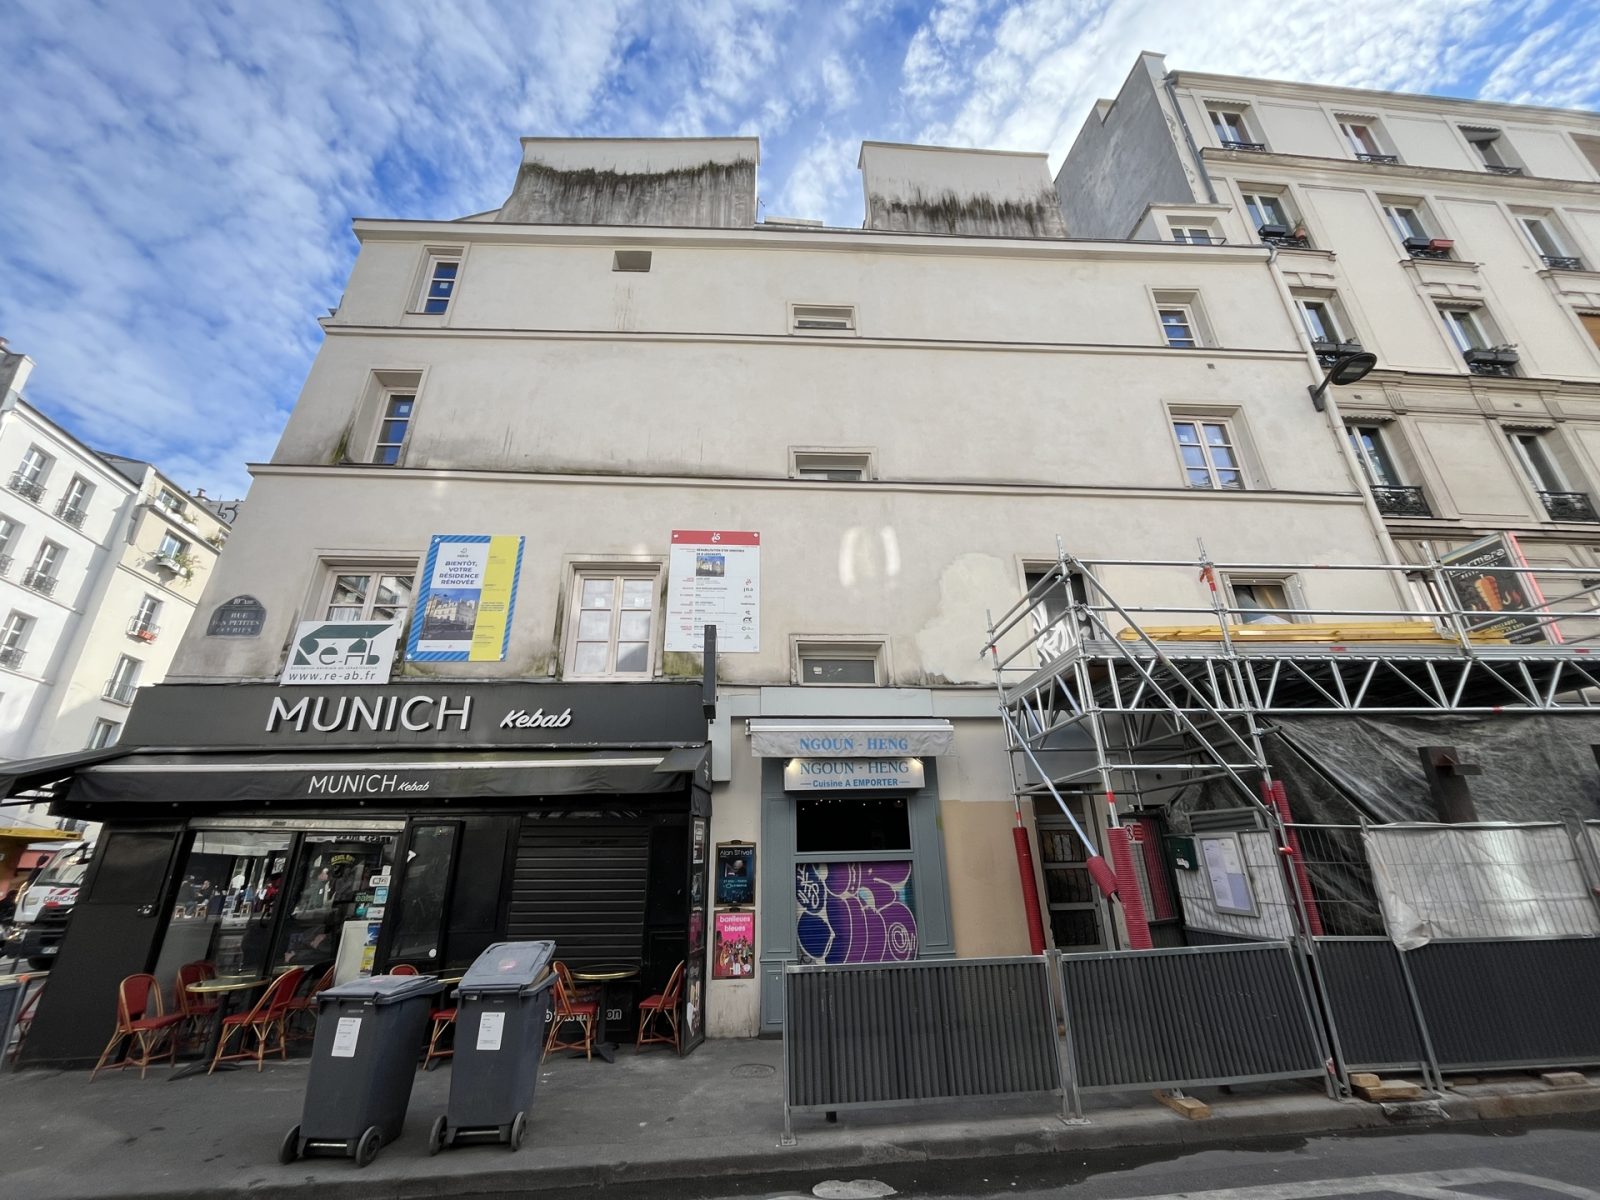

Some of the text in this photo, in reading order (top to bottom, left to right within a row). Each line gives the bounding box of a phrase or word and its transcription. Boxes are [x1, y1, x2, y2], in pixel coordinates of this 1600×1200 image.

[289, 670, 376, 681] www.re-ab.fr
[265, 695, 572, 732] MUNICH Kebab
[799, 738, 853, 751] NGOUN
[867, 738, 908, 750] HENG
[800, 762, 854, 775] NGOUN
[868, 761, 909, 774] HENG
[308, 774, 430, 793] MUNICH Kebab
[812, 779, 843, 787] Cuisine
[853, 778, 898, 787] EMPORTER
